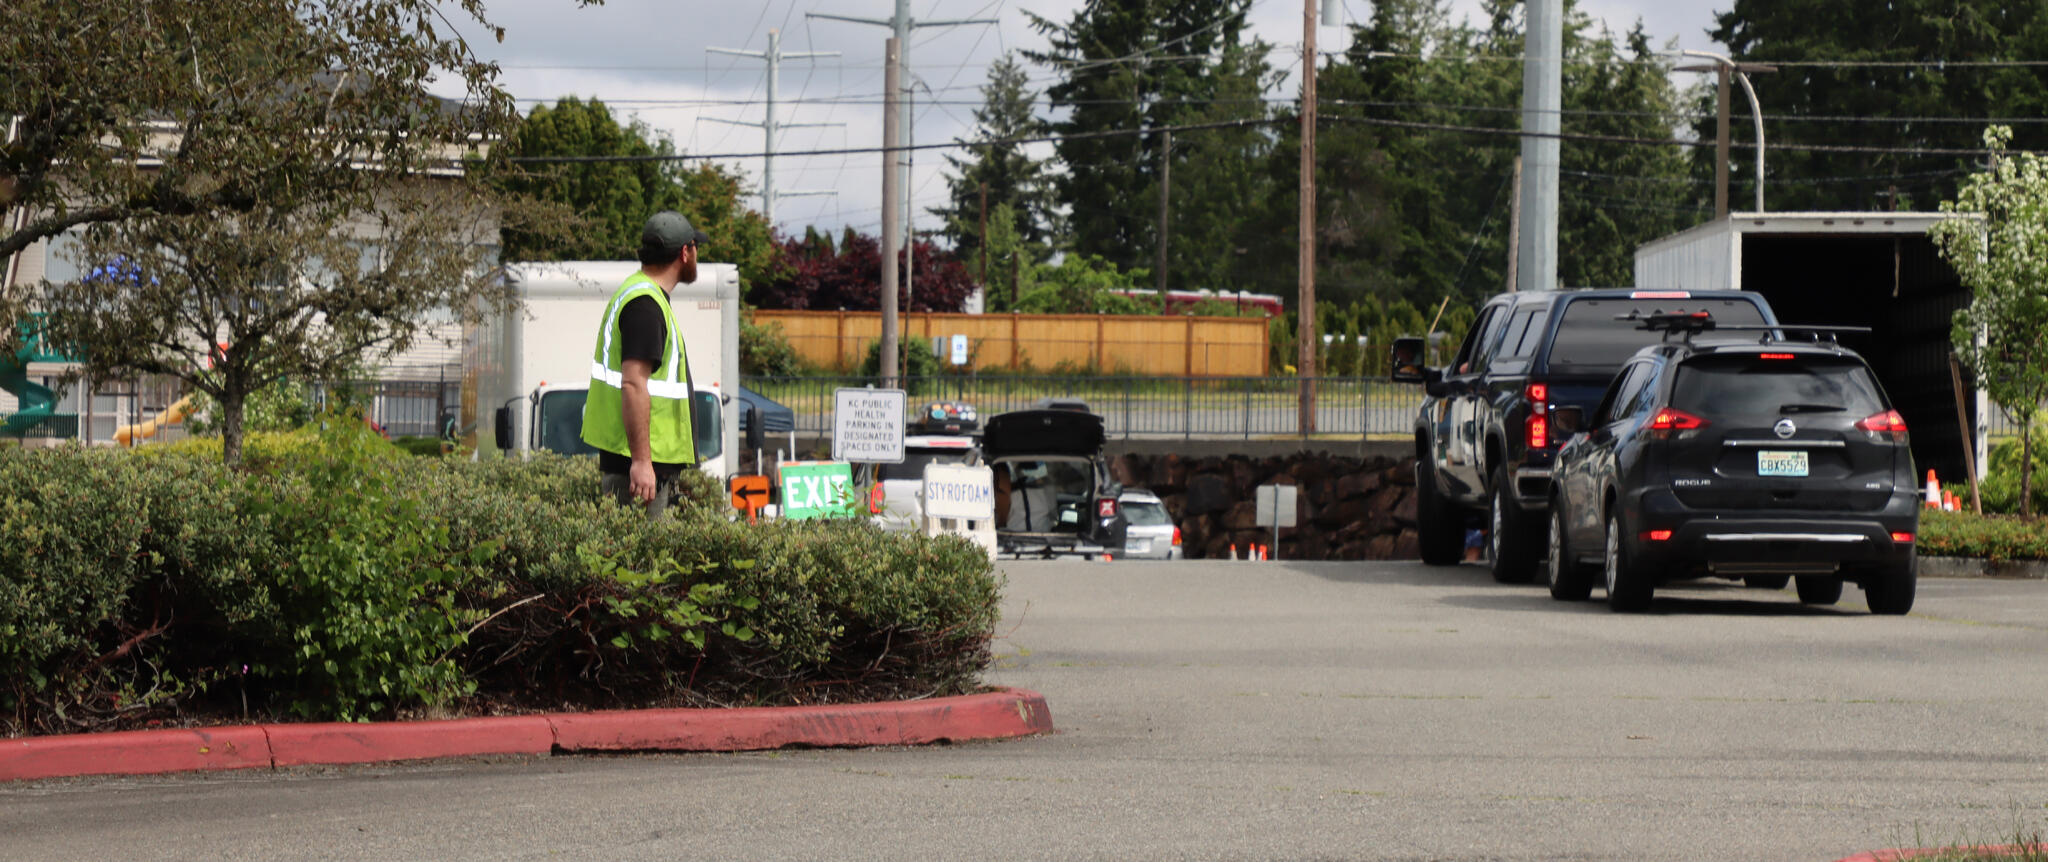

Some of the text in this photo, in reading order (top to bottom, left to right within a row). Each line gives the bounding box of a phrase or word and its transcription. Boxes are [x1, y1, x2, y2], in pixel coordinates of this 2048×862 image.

[848, 400, 893, 409] KC PUBLIC
[854, 410, 886, 419] HEALTH
[846, 420, 894, 430] PARKING IN
[844, 431, 894, 441] DESIGNATED
[841, 441, 897, 452] SPACES ONLY
[1760, 459, 1807, 473] CBX5529
[785, 474, 848, 509] EXIT
[928, 482, 989, 503] STYROFOAM
